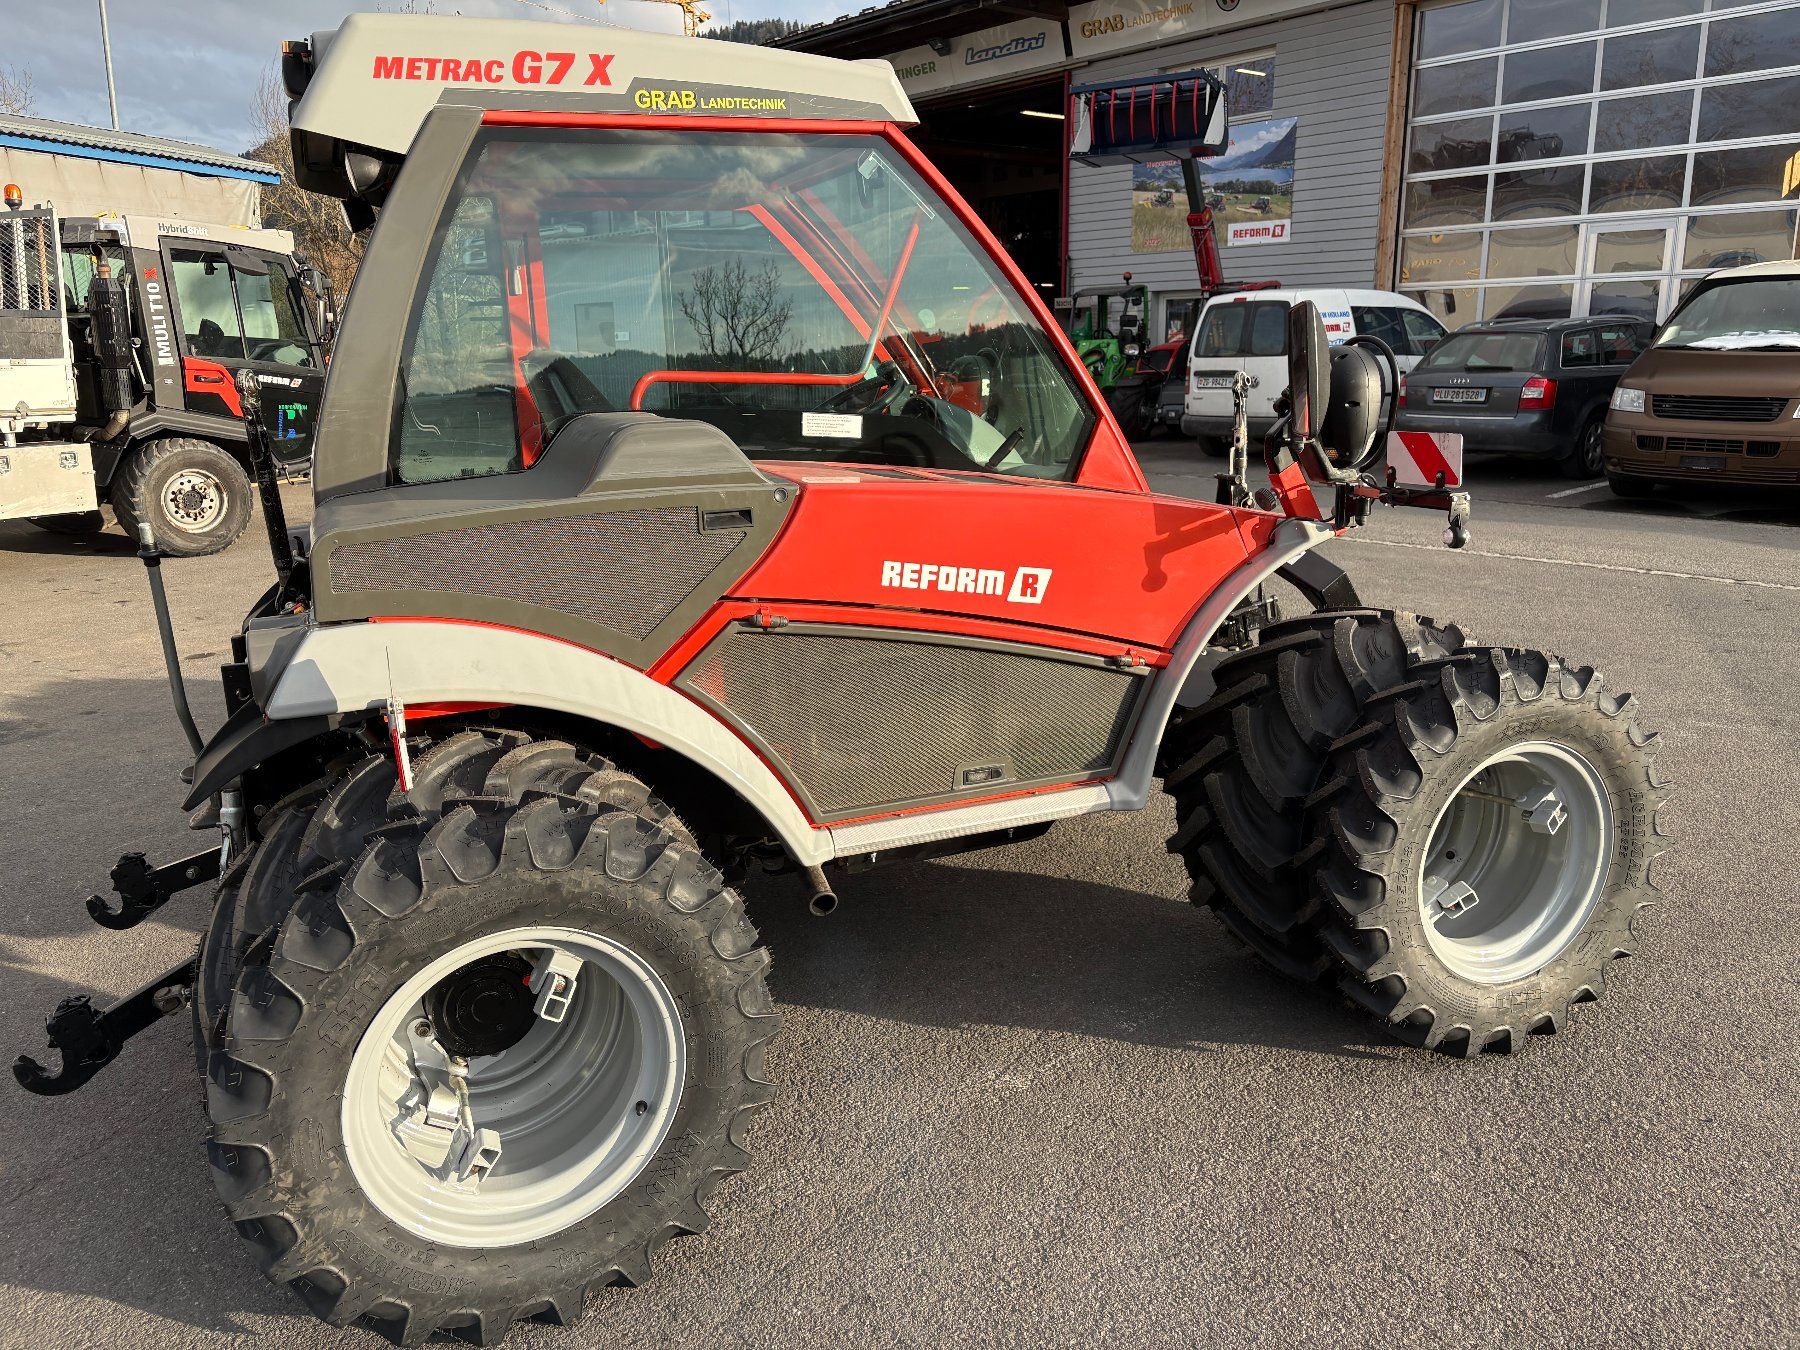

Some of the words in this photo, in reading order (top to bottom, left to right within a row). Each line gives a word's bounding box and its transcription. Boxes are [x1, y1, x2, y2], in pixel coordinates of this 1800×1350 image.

[1081, 14, 1124, 38] GRAB
[1126, 3, 1194, 28] LANDTECHNIK
[965, 32, 1045, 65] Landini
[373, 56, 504, 83] METRAC
[512, 50, 576, 84] G7
[583, 53, 615, 86] X
[895, 61, 936, 80] TINGER
[634, 89, 697, 111] GRAB
[701, 98, 787, 110] LANDTECHNIK
[1233, 228, 1270, 239] REFORM
[143, 267, 159, 280] X
[146, 282, 164, 313] T10
[152, 315, 175, 366] MULI
[881, 560, 1005, 596] REFORM
